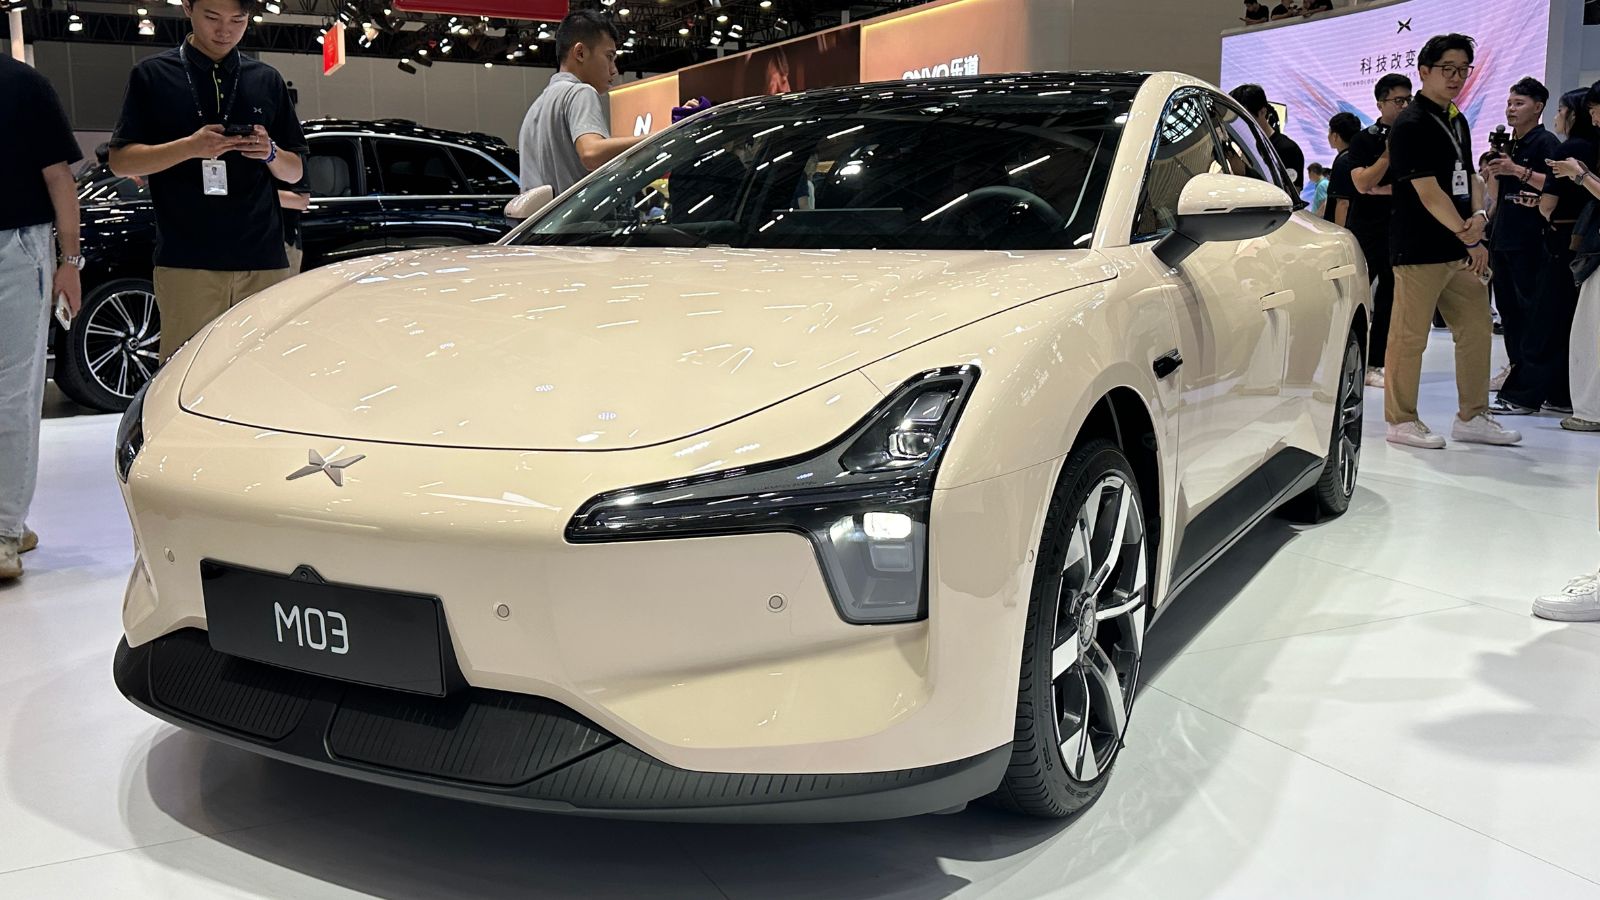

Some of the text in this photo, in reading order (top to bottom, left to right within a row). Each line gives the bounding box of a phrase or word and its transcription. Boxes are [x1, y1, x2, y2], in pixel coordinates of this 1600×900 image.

[1360, 49, 1416, 75] 科技改变
[274, 601, 349, 655] M03
